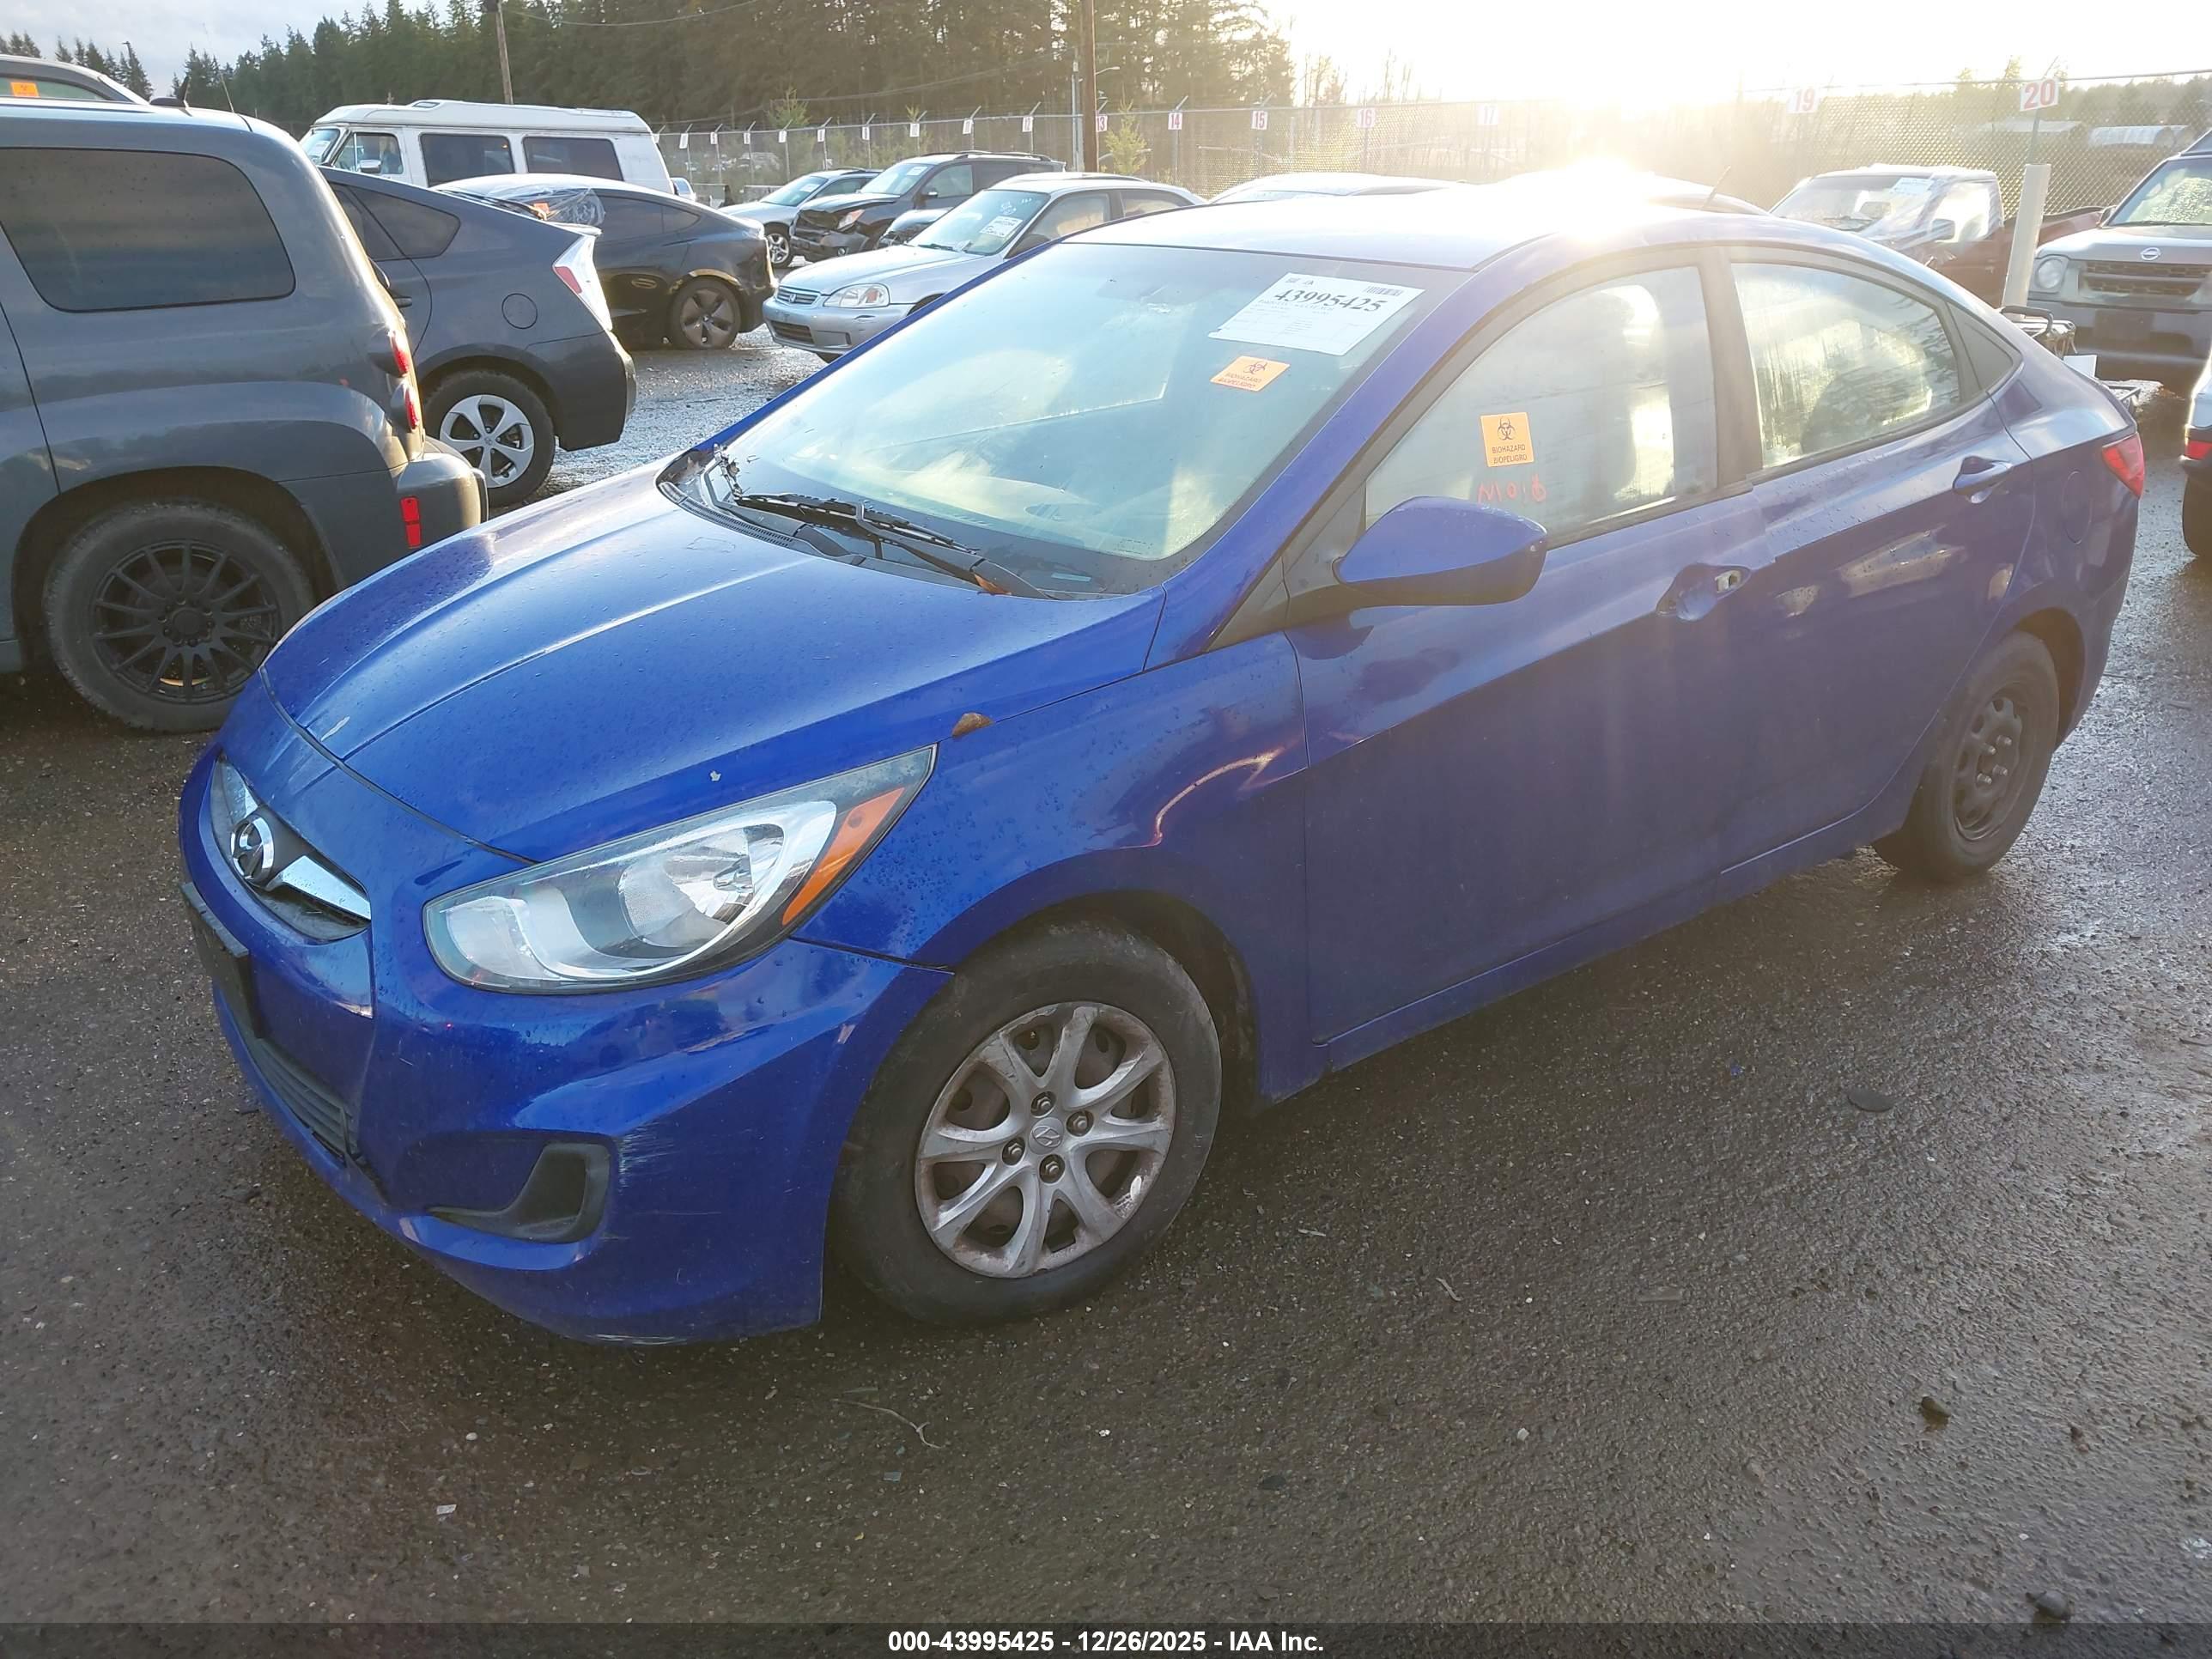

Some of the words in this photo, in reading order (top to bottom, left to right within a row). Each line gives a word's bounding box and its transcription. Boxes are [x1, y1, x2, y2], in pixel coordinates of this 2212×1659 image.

[1796, 88, 1814, 112] 19
[2024, 79, 2056, 109] 20
[1170, 113, 1180, 129] 14
[1255, 112, 1265, 129] 15
[1360, 109, 1373, 126] 16
[1484, 105, 1495, 125] 17
[1274, 289, 1388, 312] 43995425
[1492, 444, 1526, 454] BIOHAZARD
[1493, 453, 1528, 465] BIOPELIGRO
